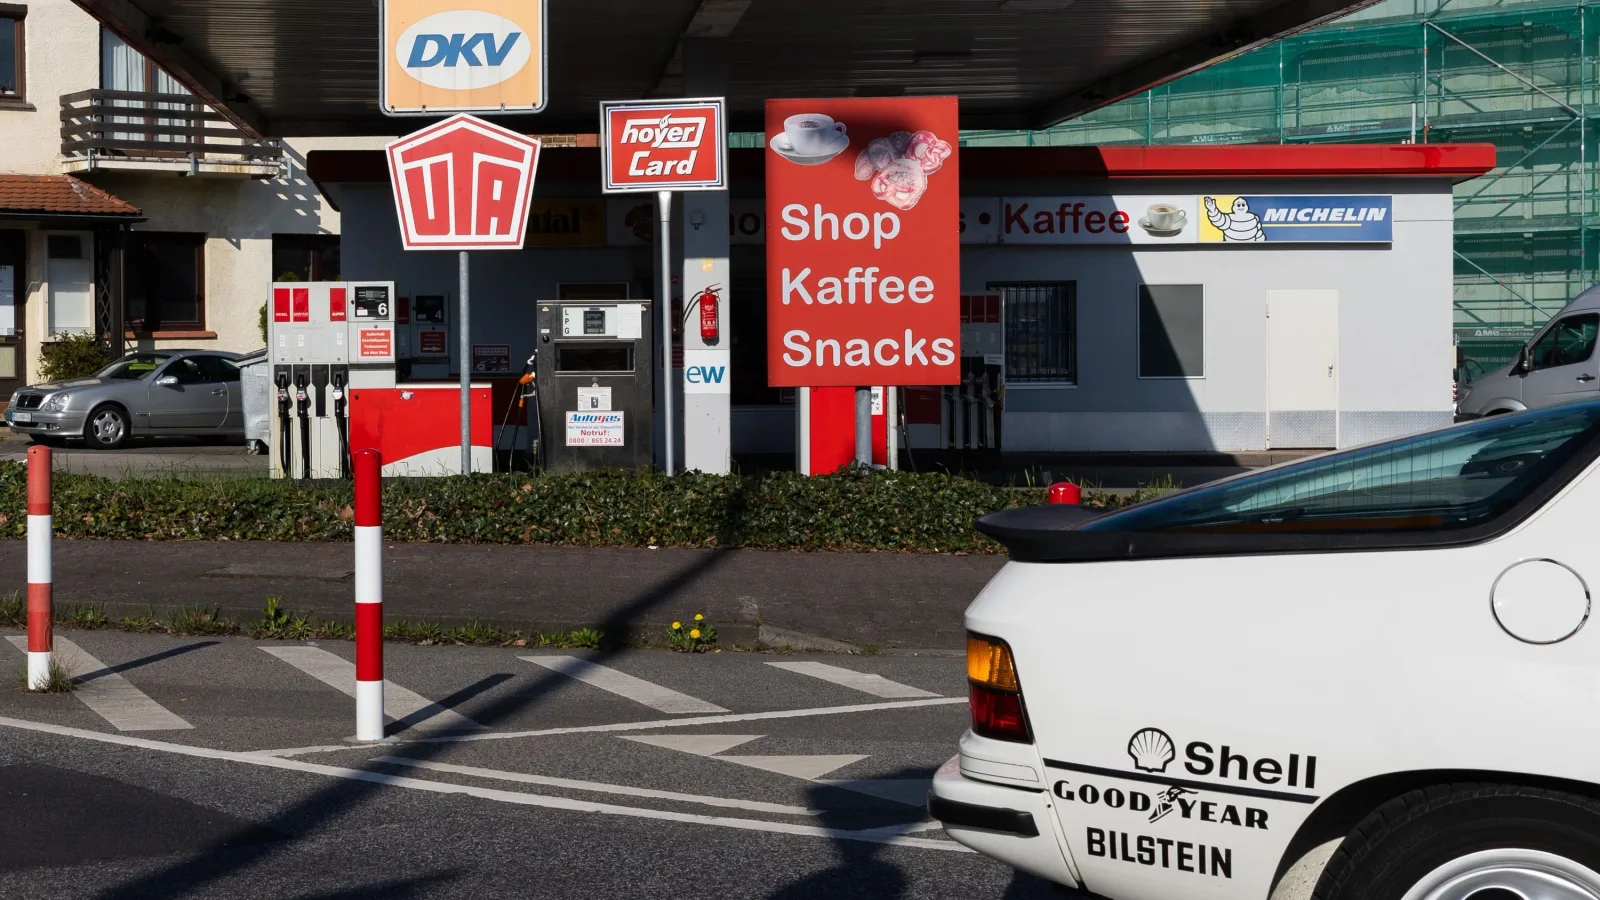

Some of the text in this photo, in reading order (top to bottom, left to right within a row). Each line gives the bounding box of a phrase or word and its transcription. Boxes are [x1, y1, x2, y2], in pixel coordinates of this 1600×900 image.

[406, 32, 522, 68] DKV
[620, 116, 695, 148] hoyer
[628, 150, 698, 177] Card
[402, 129, 525, 236] UTA
[780, 203, 901, 249] Shop
[1004, 203, 1130, 234] Kaffee
[1263, 207, 1387, 222] MICHELIN
[781, 266, 935, 305] Kaffee
[377, 303, 387, 316] 6
[434, 309, 442, 320] 4
[782, 328, 956, 367] Snacks
[686, 365, 725, 384] ew
[569, 413, 621, 423] Autogas
[1184, 741, 1318, 789] Shell
[1053, 780, 1269, 830] GOOD YEAR
[1086, 827, 1232, 879] BILSTEIN
